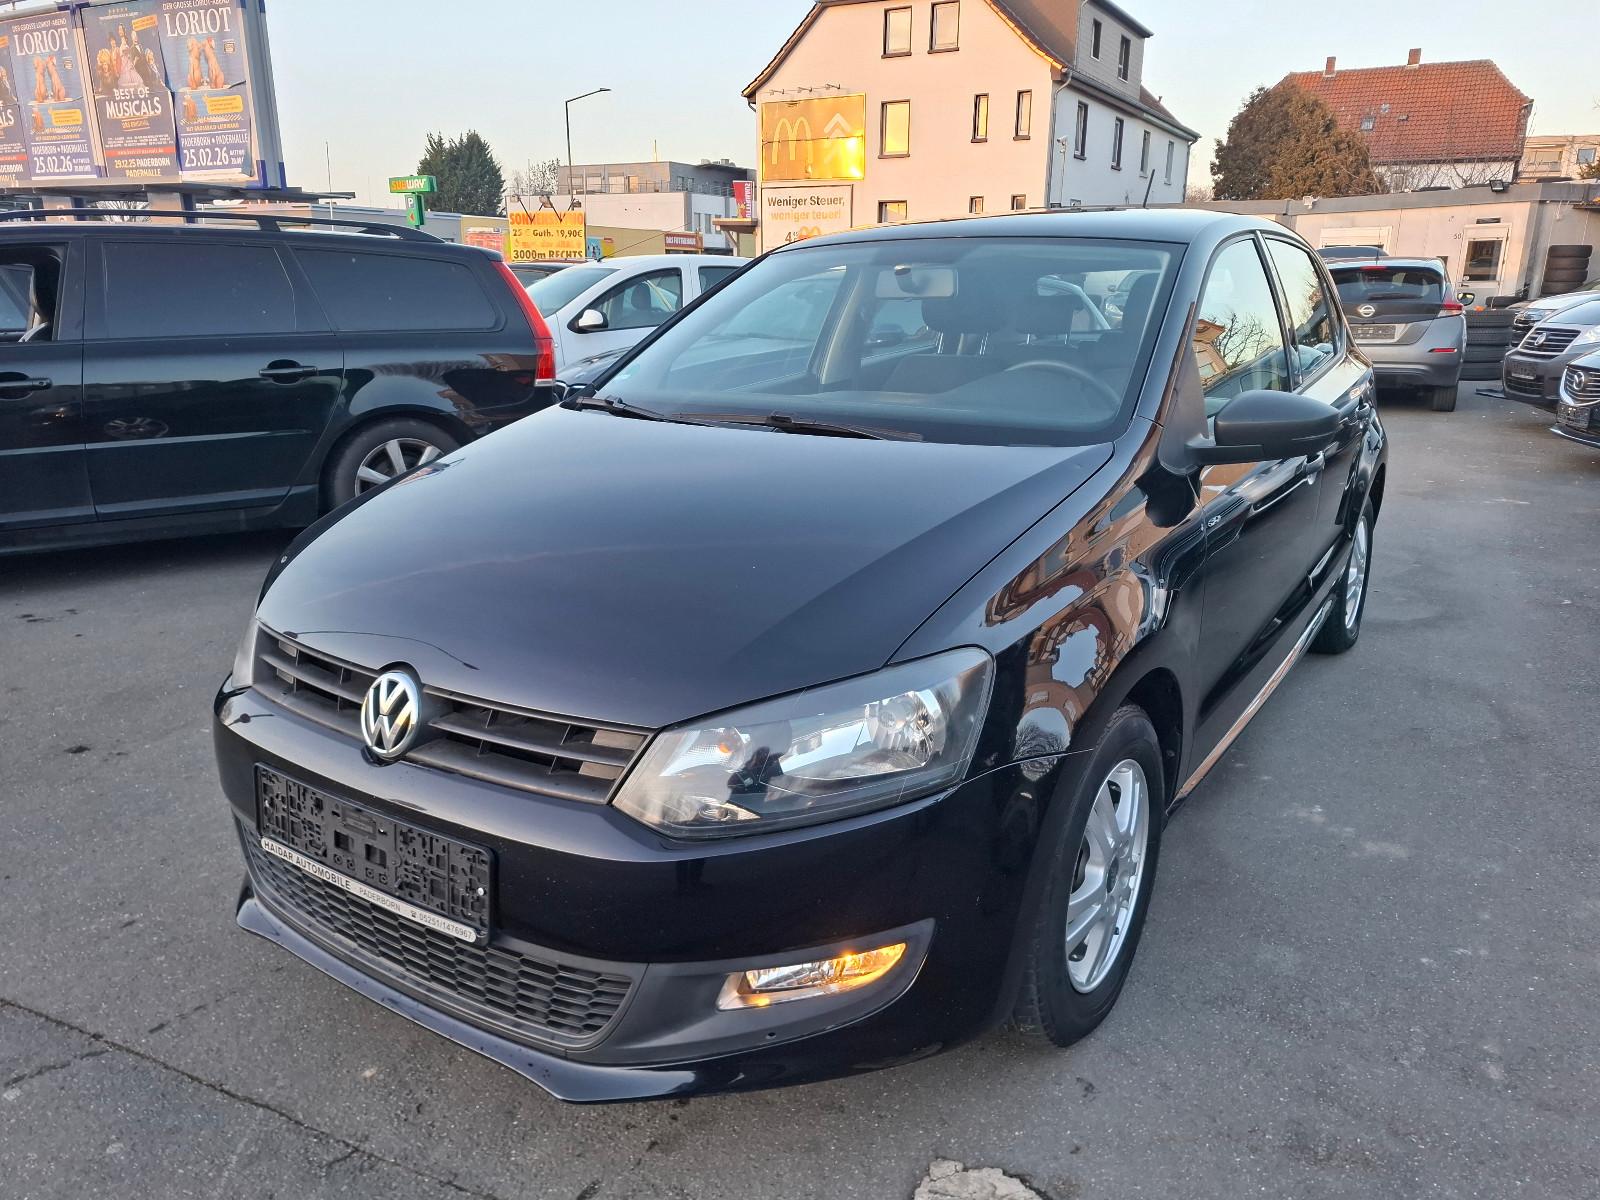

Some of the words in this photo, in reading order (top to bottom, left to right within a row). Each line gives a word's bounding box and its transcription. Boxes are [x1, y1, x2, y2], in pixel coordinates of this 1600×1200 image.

[164, 7, 232, 37] LORIOT
[13, 27, 69, 56] LORIOT
[113, 88, 135, 100] BEST
[137, 86, 150, 98] OF
[105, 96, 162, 119] MUSICALS
[181, 136, 211, 147] PADERBORN
[215, 133, 249, 145] PADERHALLE
[183, 146, 229, 168] 25.02.26
[33, 155, 73, 174] 25.02.26
[391, 179, 427, 190] SUBWAY
[408, 197, 414, 208] P
[767, 195, 807, 209] Weniger
[809, 195, 845, 207] Steuer,
[770, 209, 809, 222] weniger
[532, 228, 554, 237] Guth.
[556, 229, 583, 239] 19,90€
[513, 249, 546, 260] 3000m
[549, 250, 583, 259] RECHTS
[263, 840, 293, 861] HAIDAR
[296, 856, 352, 890] AUTOMOBILE
[359, 887, 401, 912] PADERBORN
